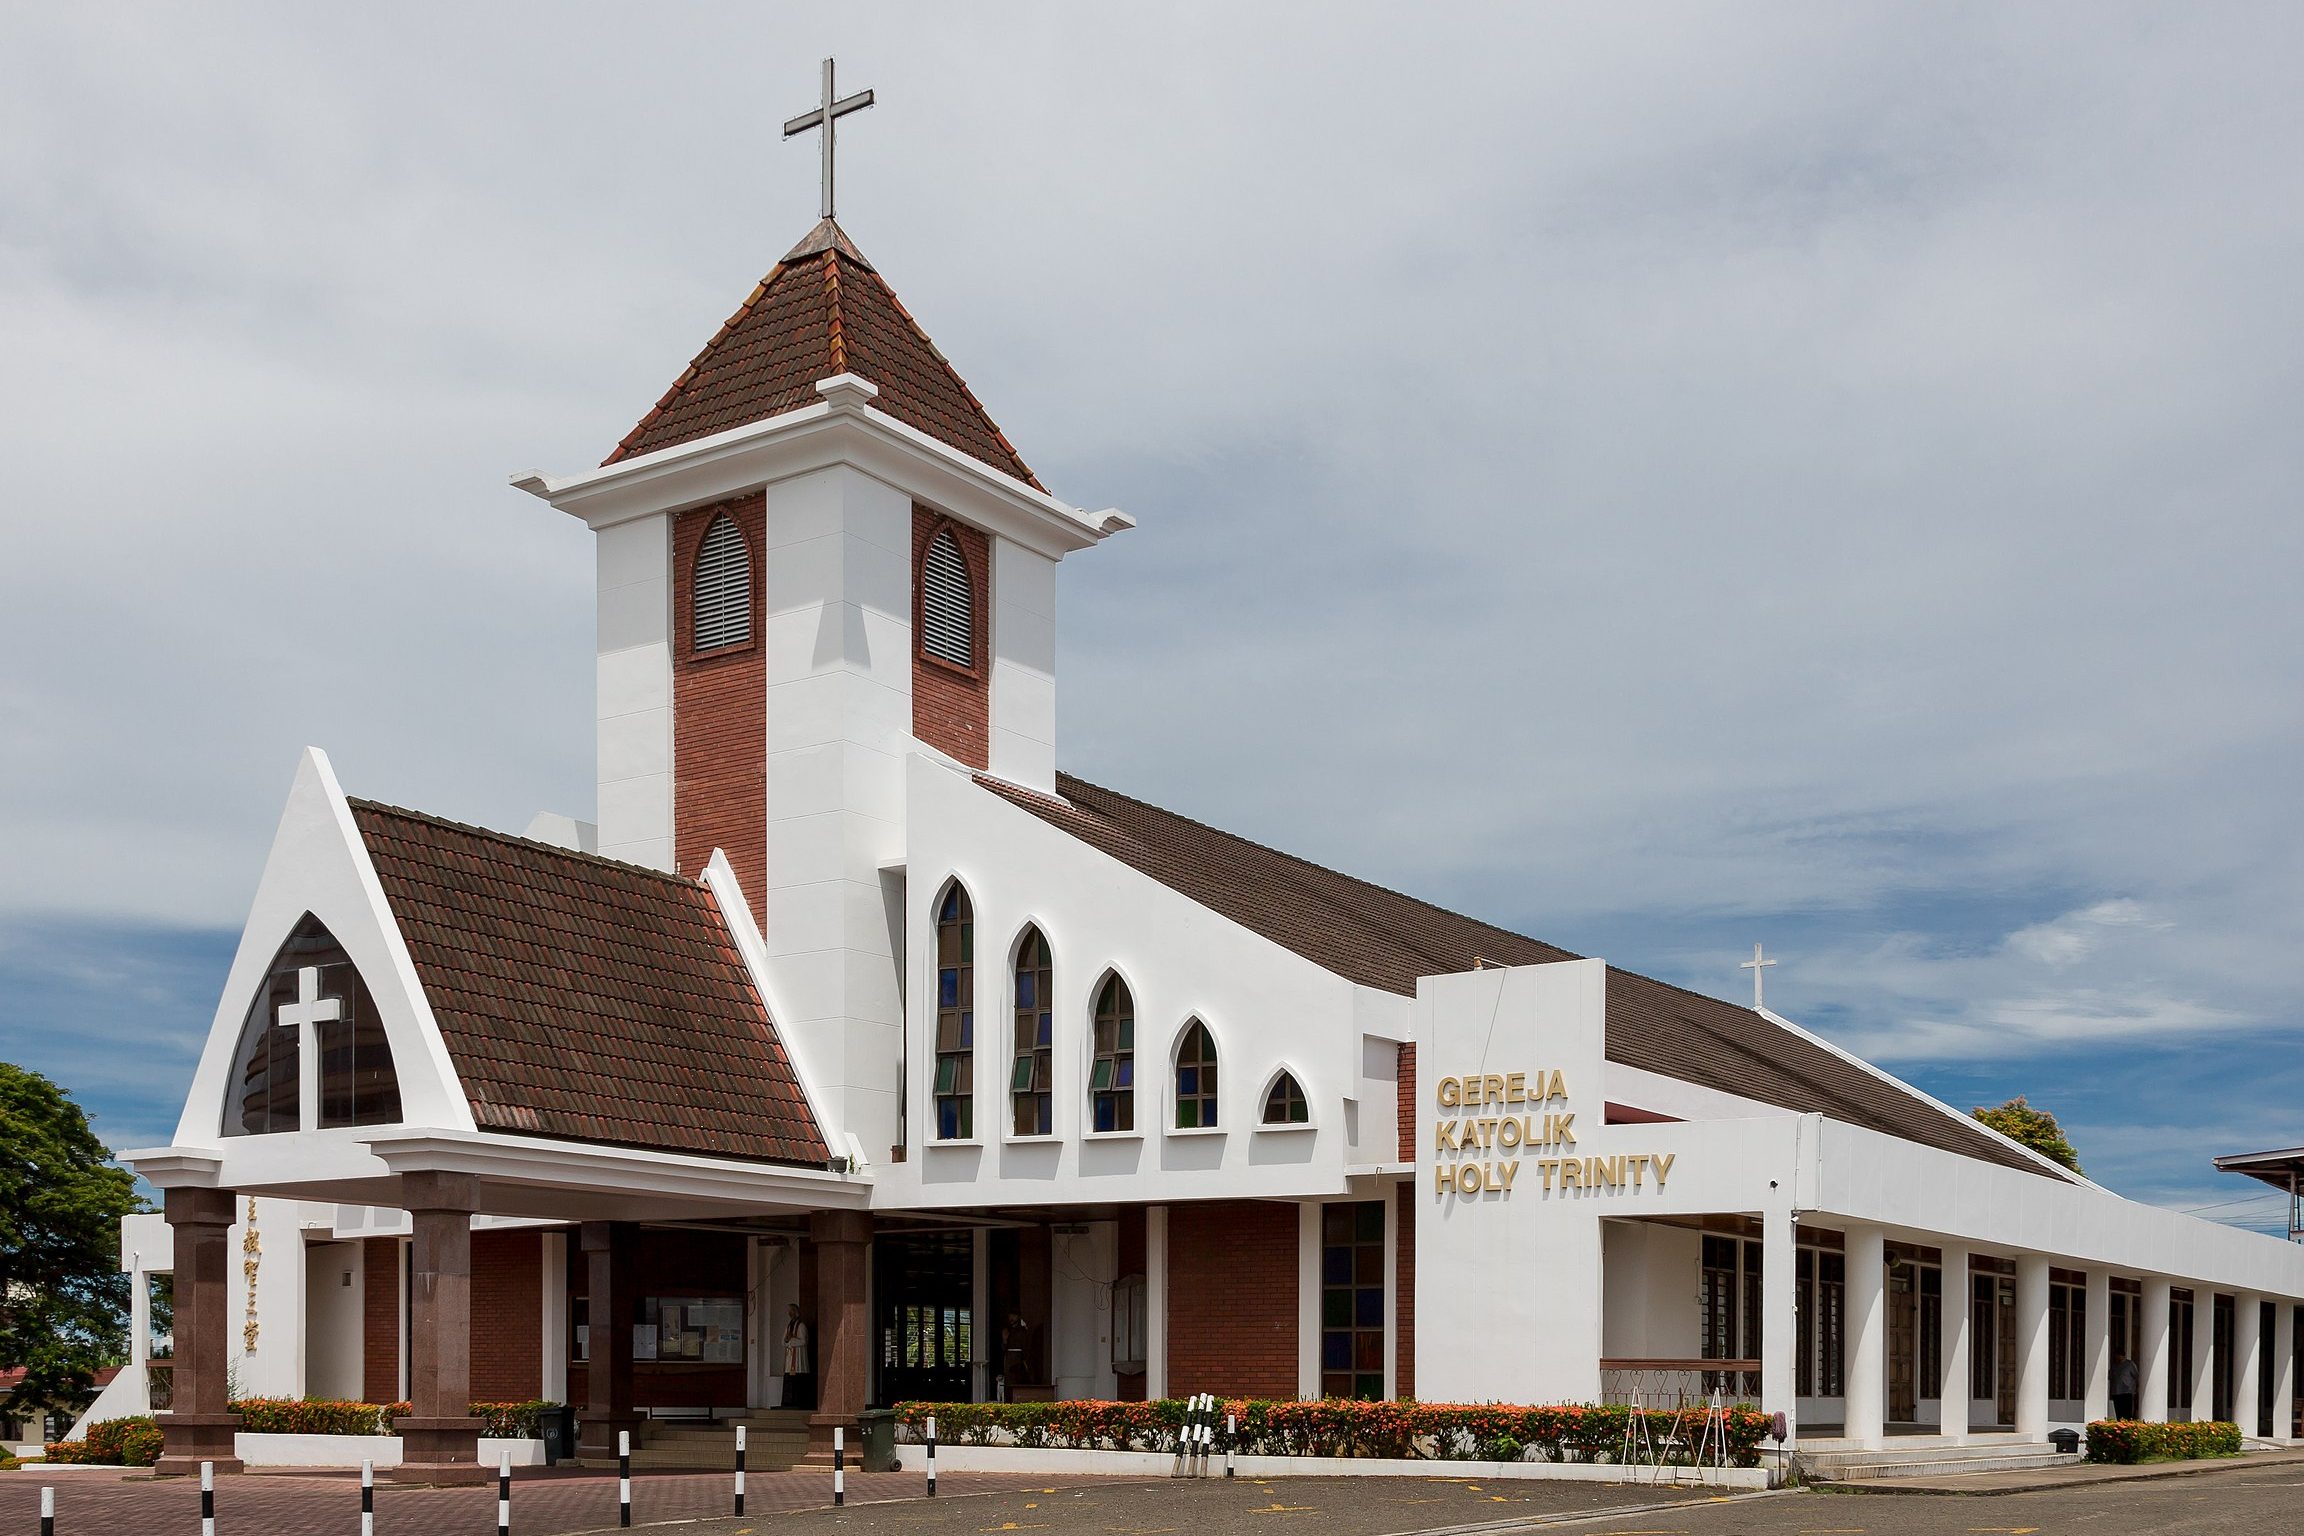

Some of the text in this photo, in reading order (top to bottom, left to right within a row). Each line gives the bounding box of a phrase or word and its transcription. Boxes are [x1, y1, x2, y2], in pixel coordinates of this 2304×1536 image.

[1437, 1070, 1568, 1107] GEREJA
[1435, 1114, 1576, 1150] KATOLIK
[1435, 1154, 1676, 1194] HOLY TRINITY
